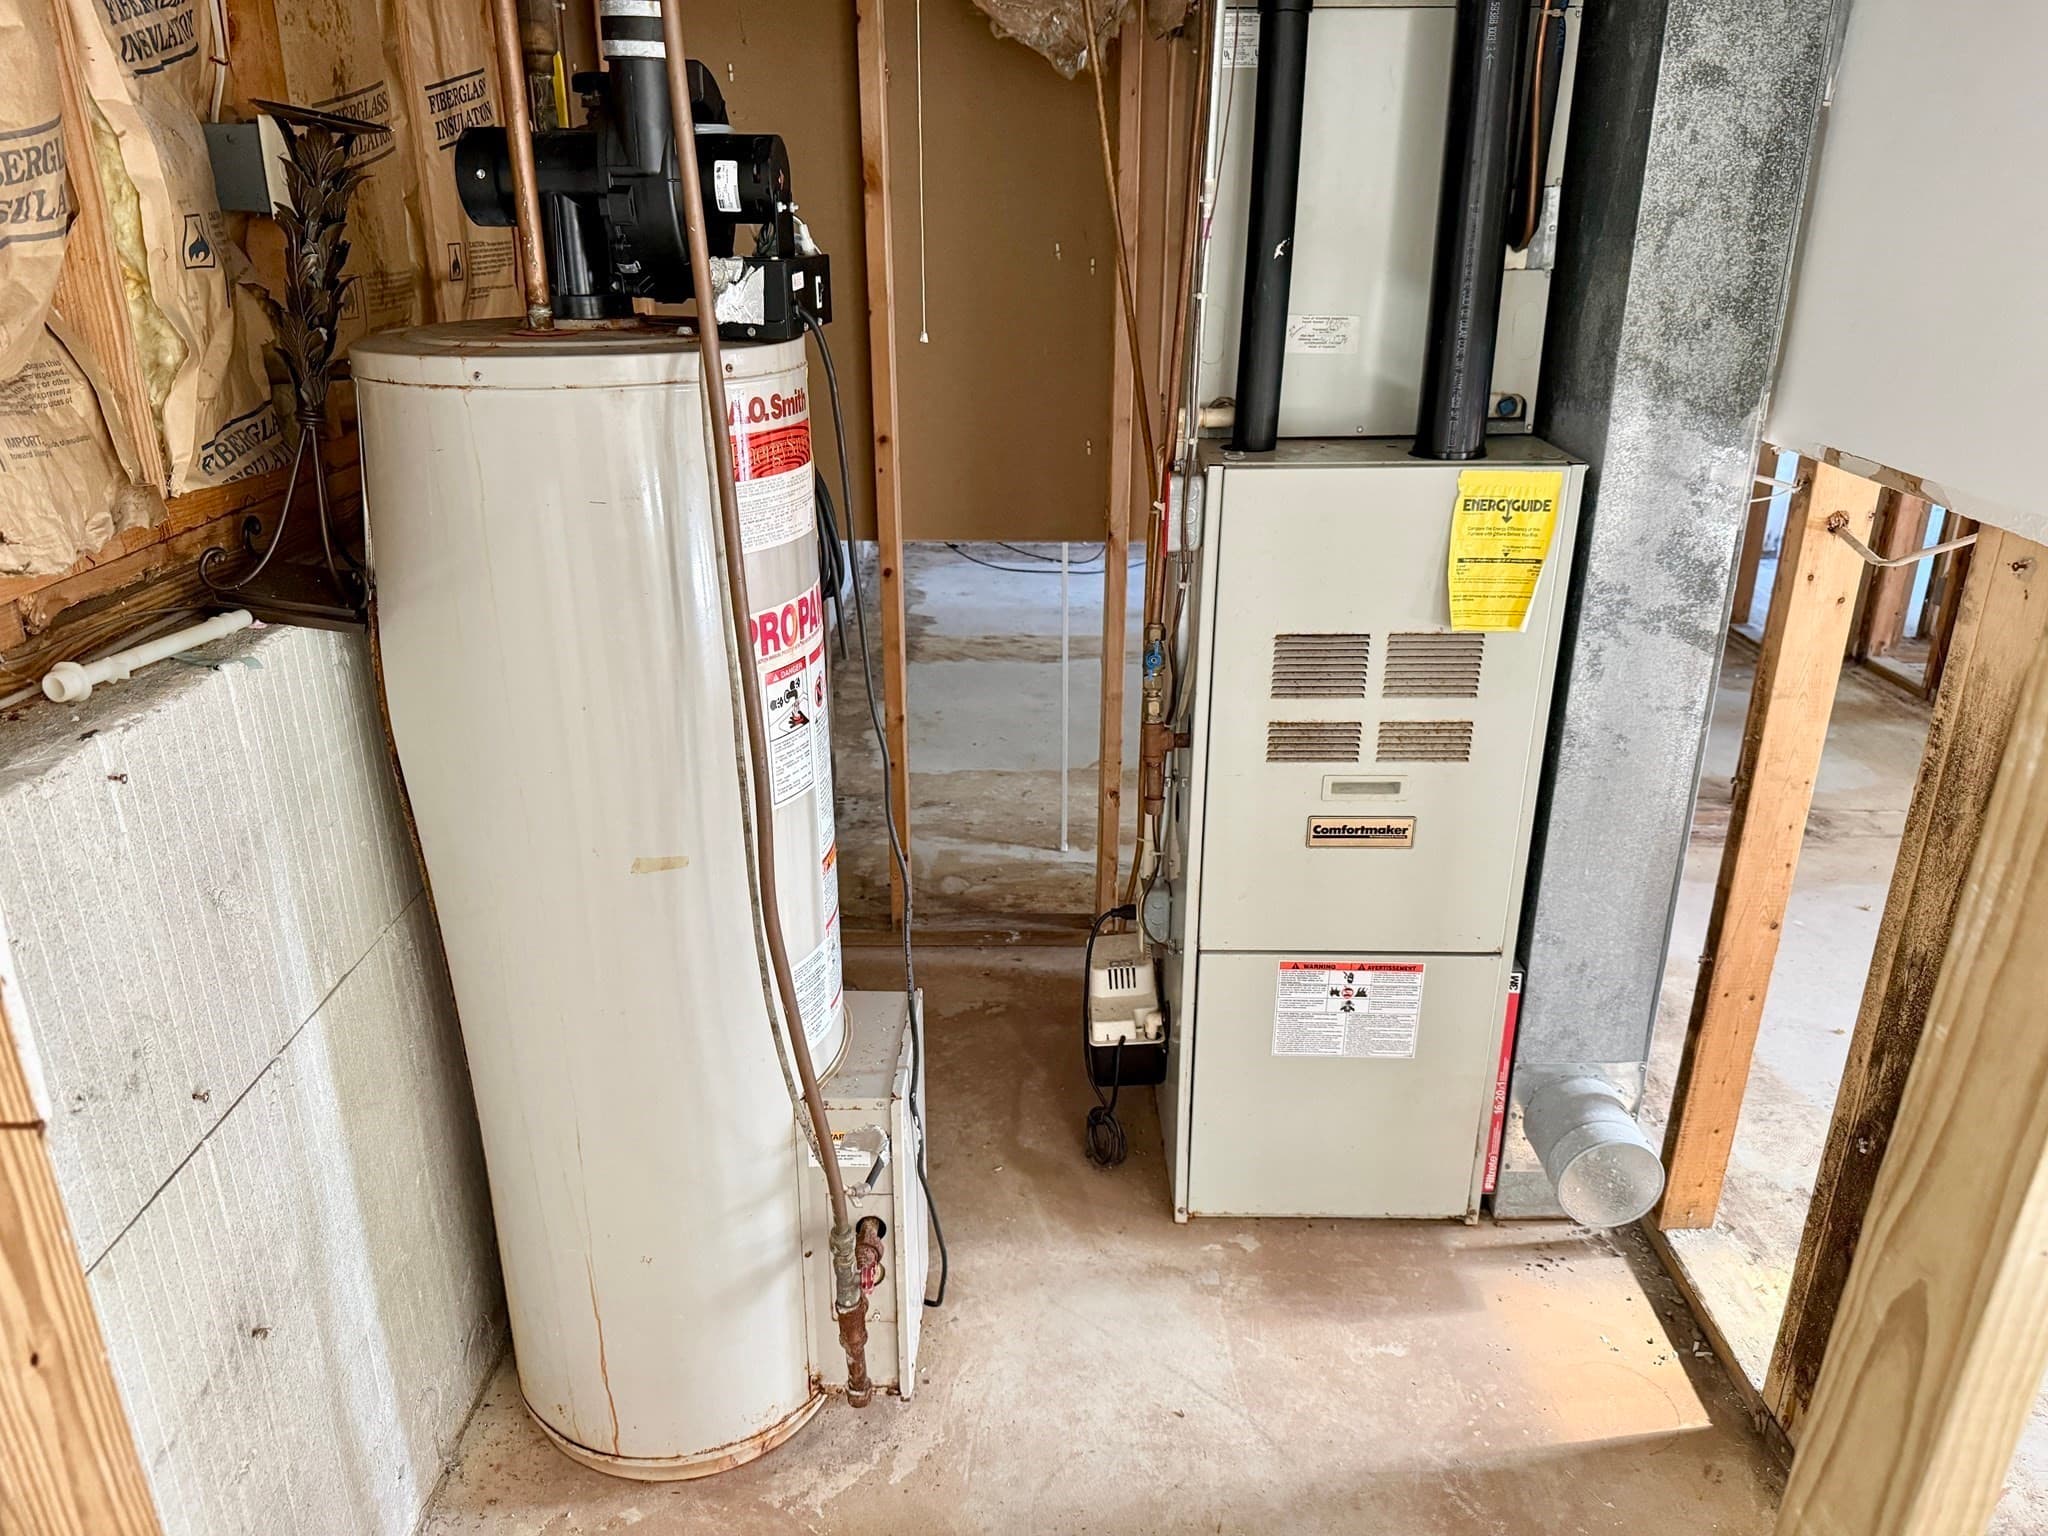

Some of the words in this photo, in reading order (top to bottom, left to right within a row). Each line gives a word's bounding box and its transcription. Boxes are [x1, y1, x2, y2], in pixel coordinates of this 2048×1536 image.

[770, 387, 806, 420] Smith
[781, 661, 803, 679] DANGER
[1313, 824, 1409, 835] Comfortmaker
[1510, 975, 1520, 991] 3M
